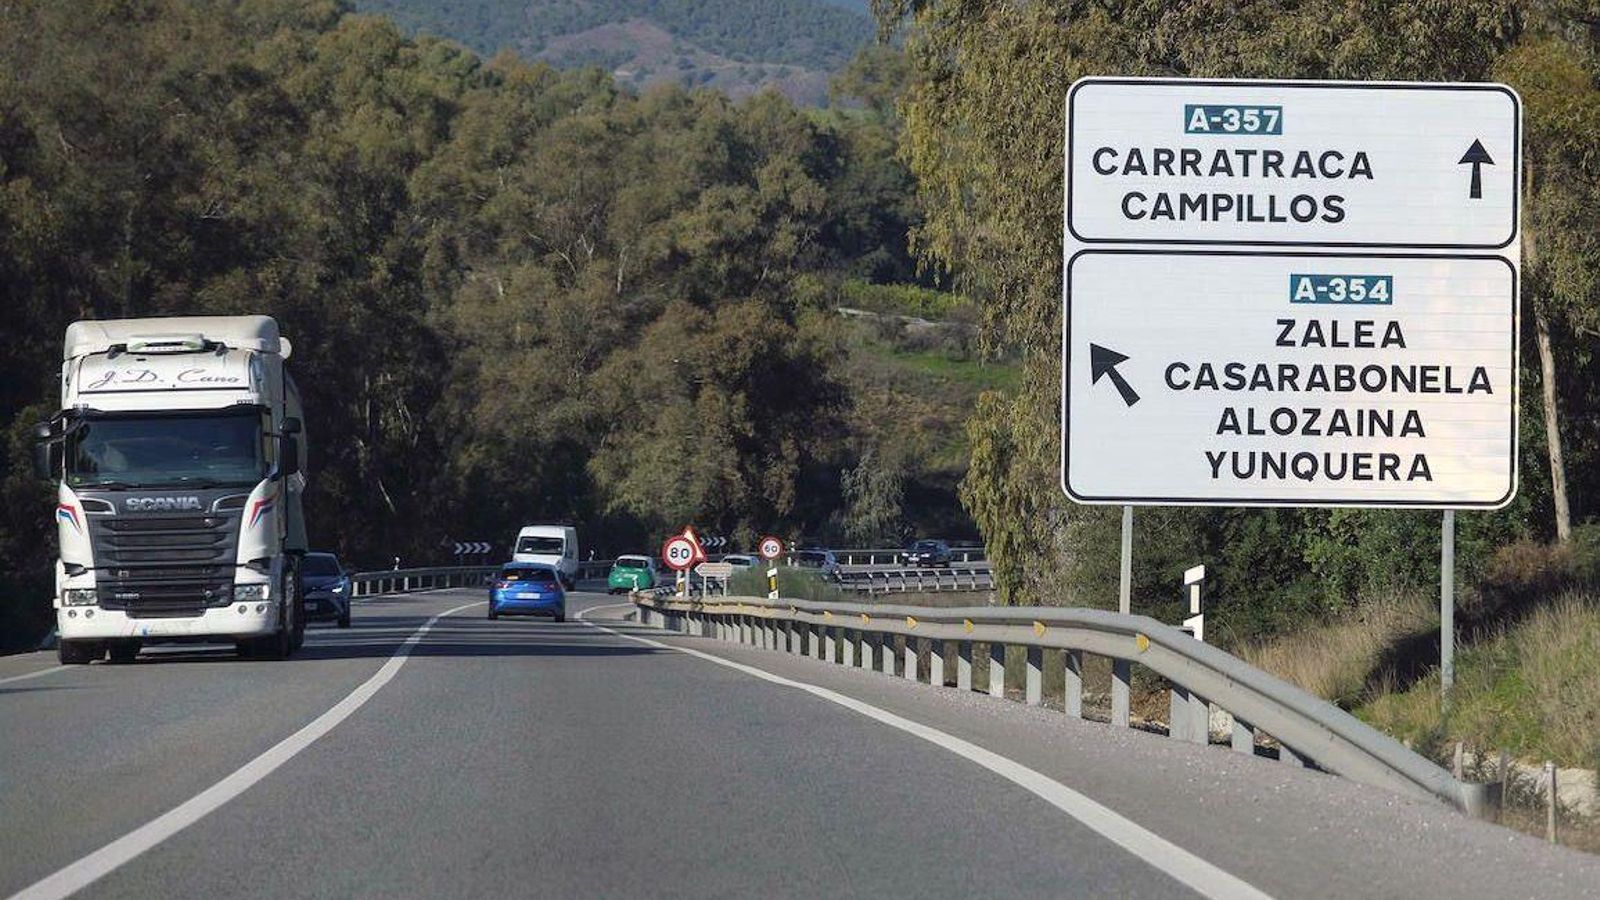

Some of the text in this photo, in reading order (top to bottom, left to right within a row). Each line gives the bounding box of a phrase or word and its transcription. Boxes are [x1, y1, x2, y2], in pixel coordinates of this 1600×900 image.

[1188, 107, 1279, 132] A-357
[1092, 146, 1374, 180] CARRATRACA
[1121, 191, 1346, 224] CAMPILLOS
[1294, 277, 1389, 302] A-354
[1275, 318, 1407, 349] ZALEA
[177, 368, 240, 383] Cano
[1164, 361, 1494, 395] CASARABONELA
[1216, 407, 1426, 438] ALOZAINA
[1204, 451, 1433, 482] YUNQUERA
[126, 496, 202, 510] SCANIA
[669, 546, 690, 559] 80
[764, 543, 778, 553] 60
